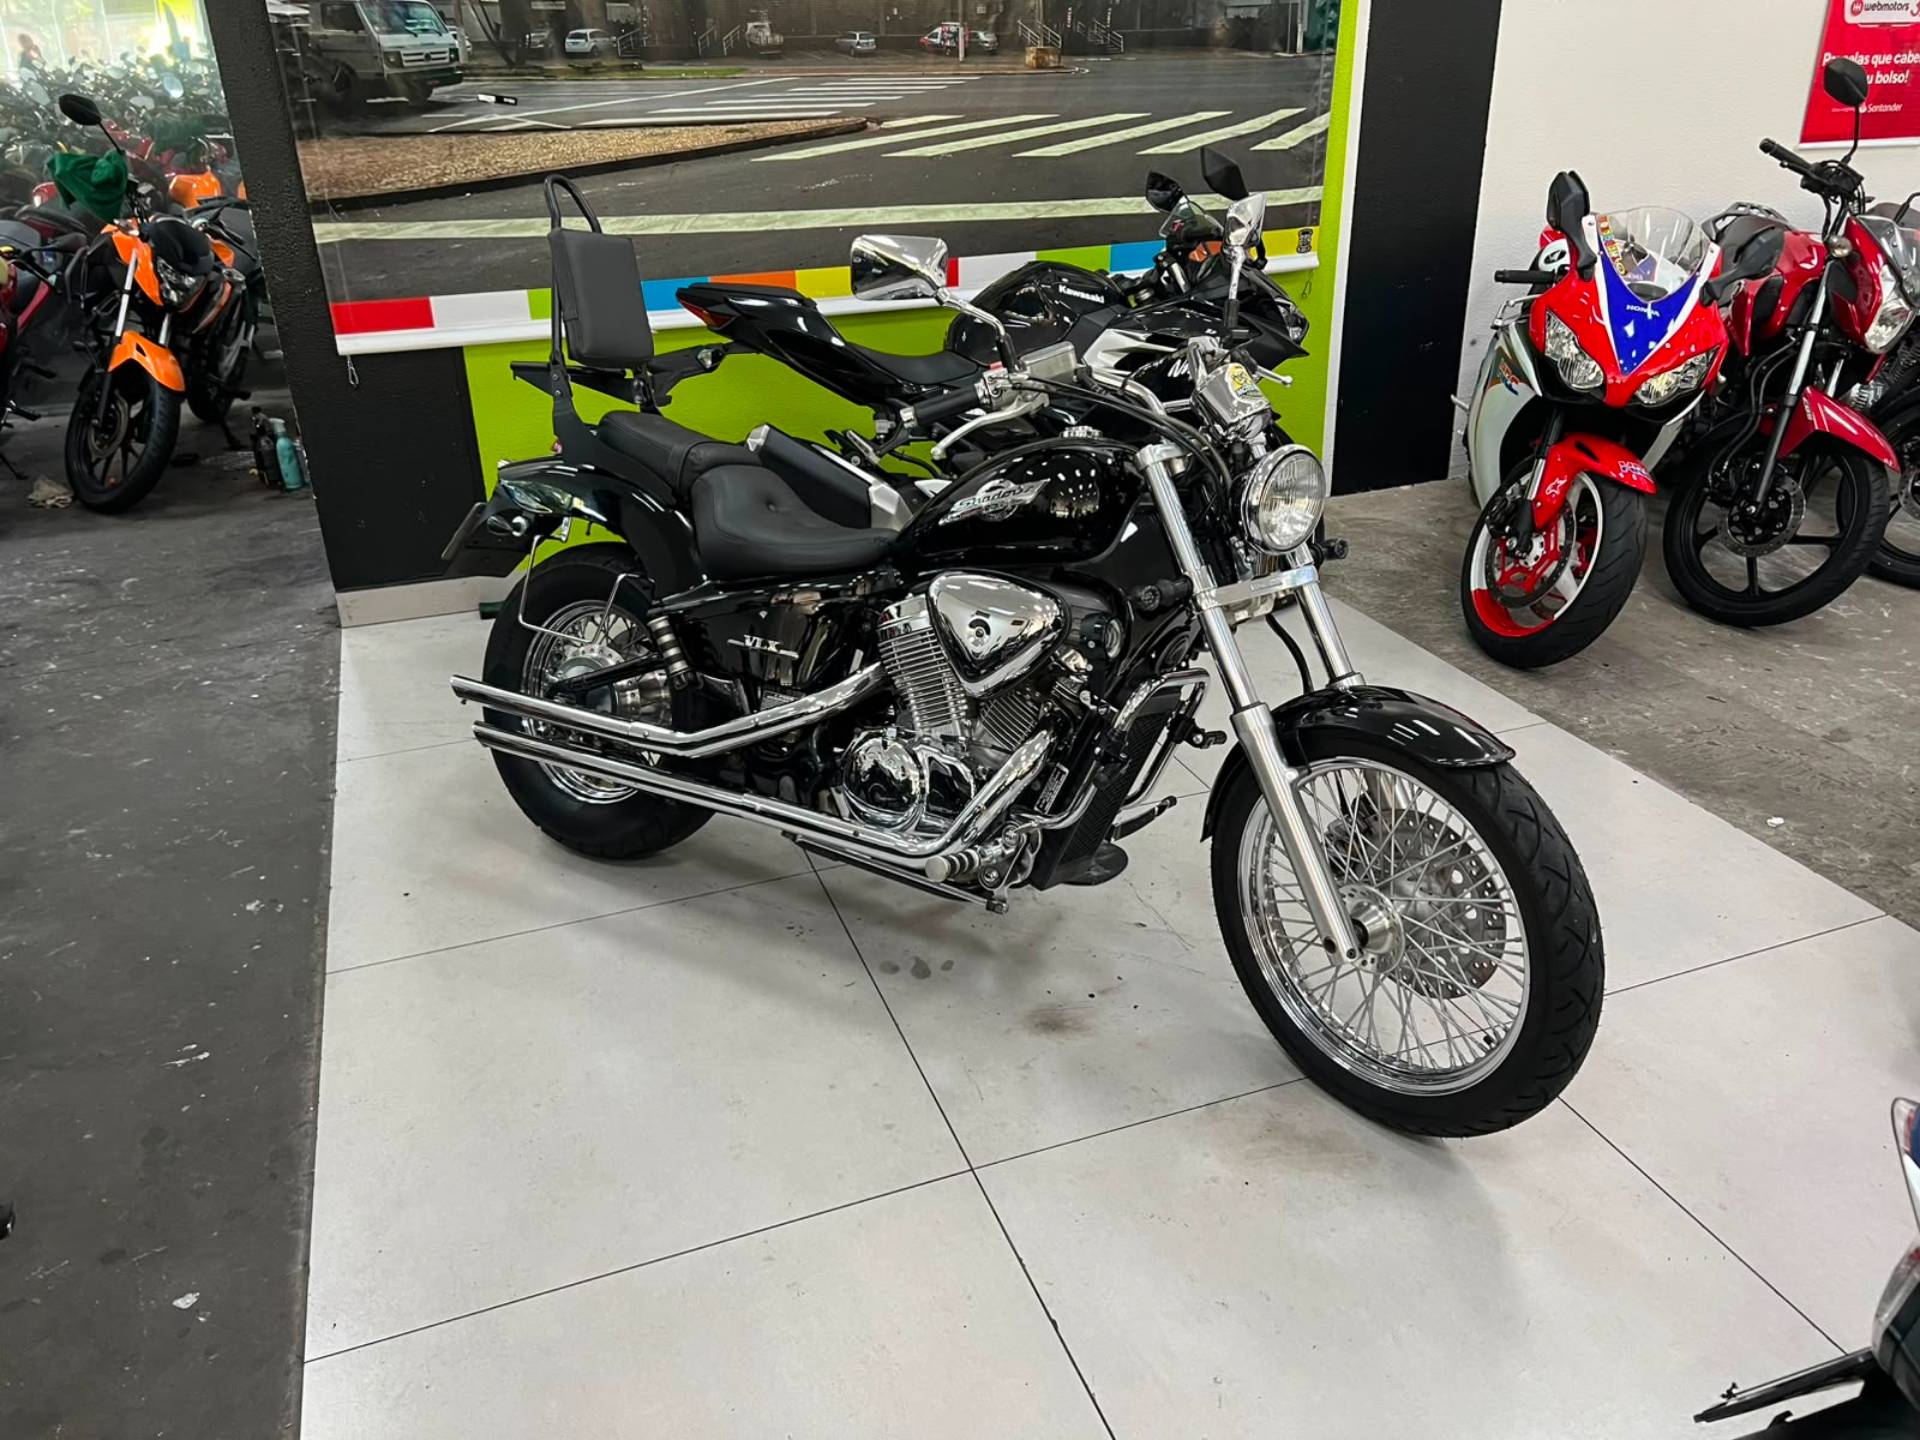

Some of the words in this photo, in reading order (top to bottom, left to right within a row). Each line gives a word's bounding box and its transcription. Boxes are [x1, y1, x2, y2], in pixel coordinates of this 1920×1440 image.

[1864, 1, 1909, 11] webmotors
[1871, 53, 1893, 68] que
[1875, 69, 1909, 84] bolso!
[1867, 103, 1903, 113] Santander
[1059, 284, 1105, 304] Kawasaki
